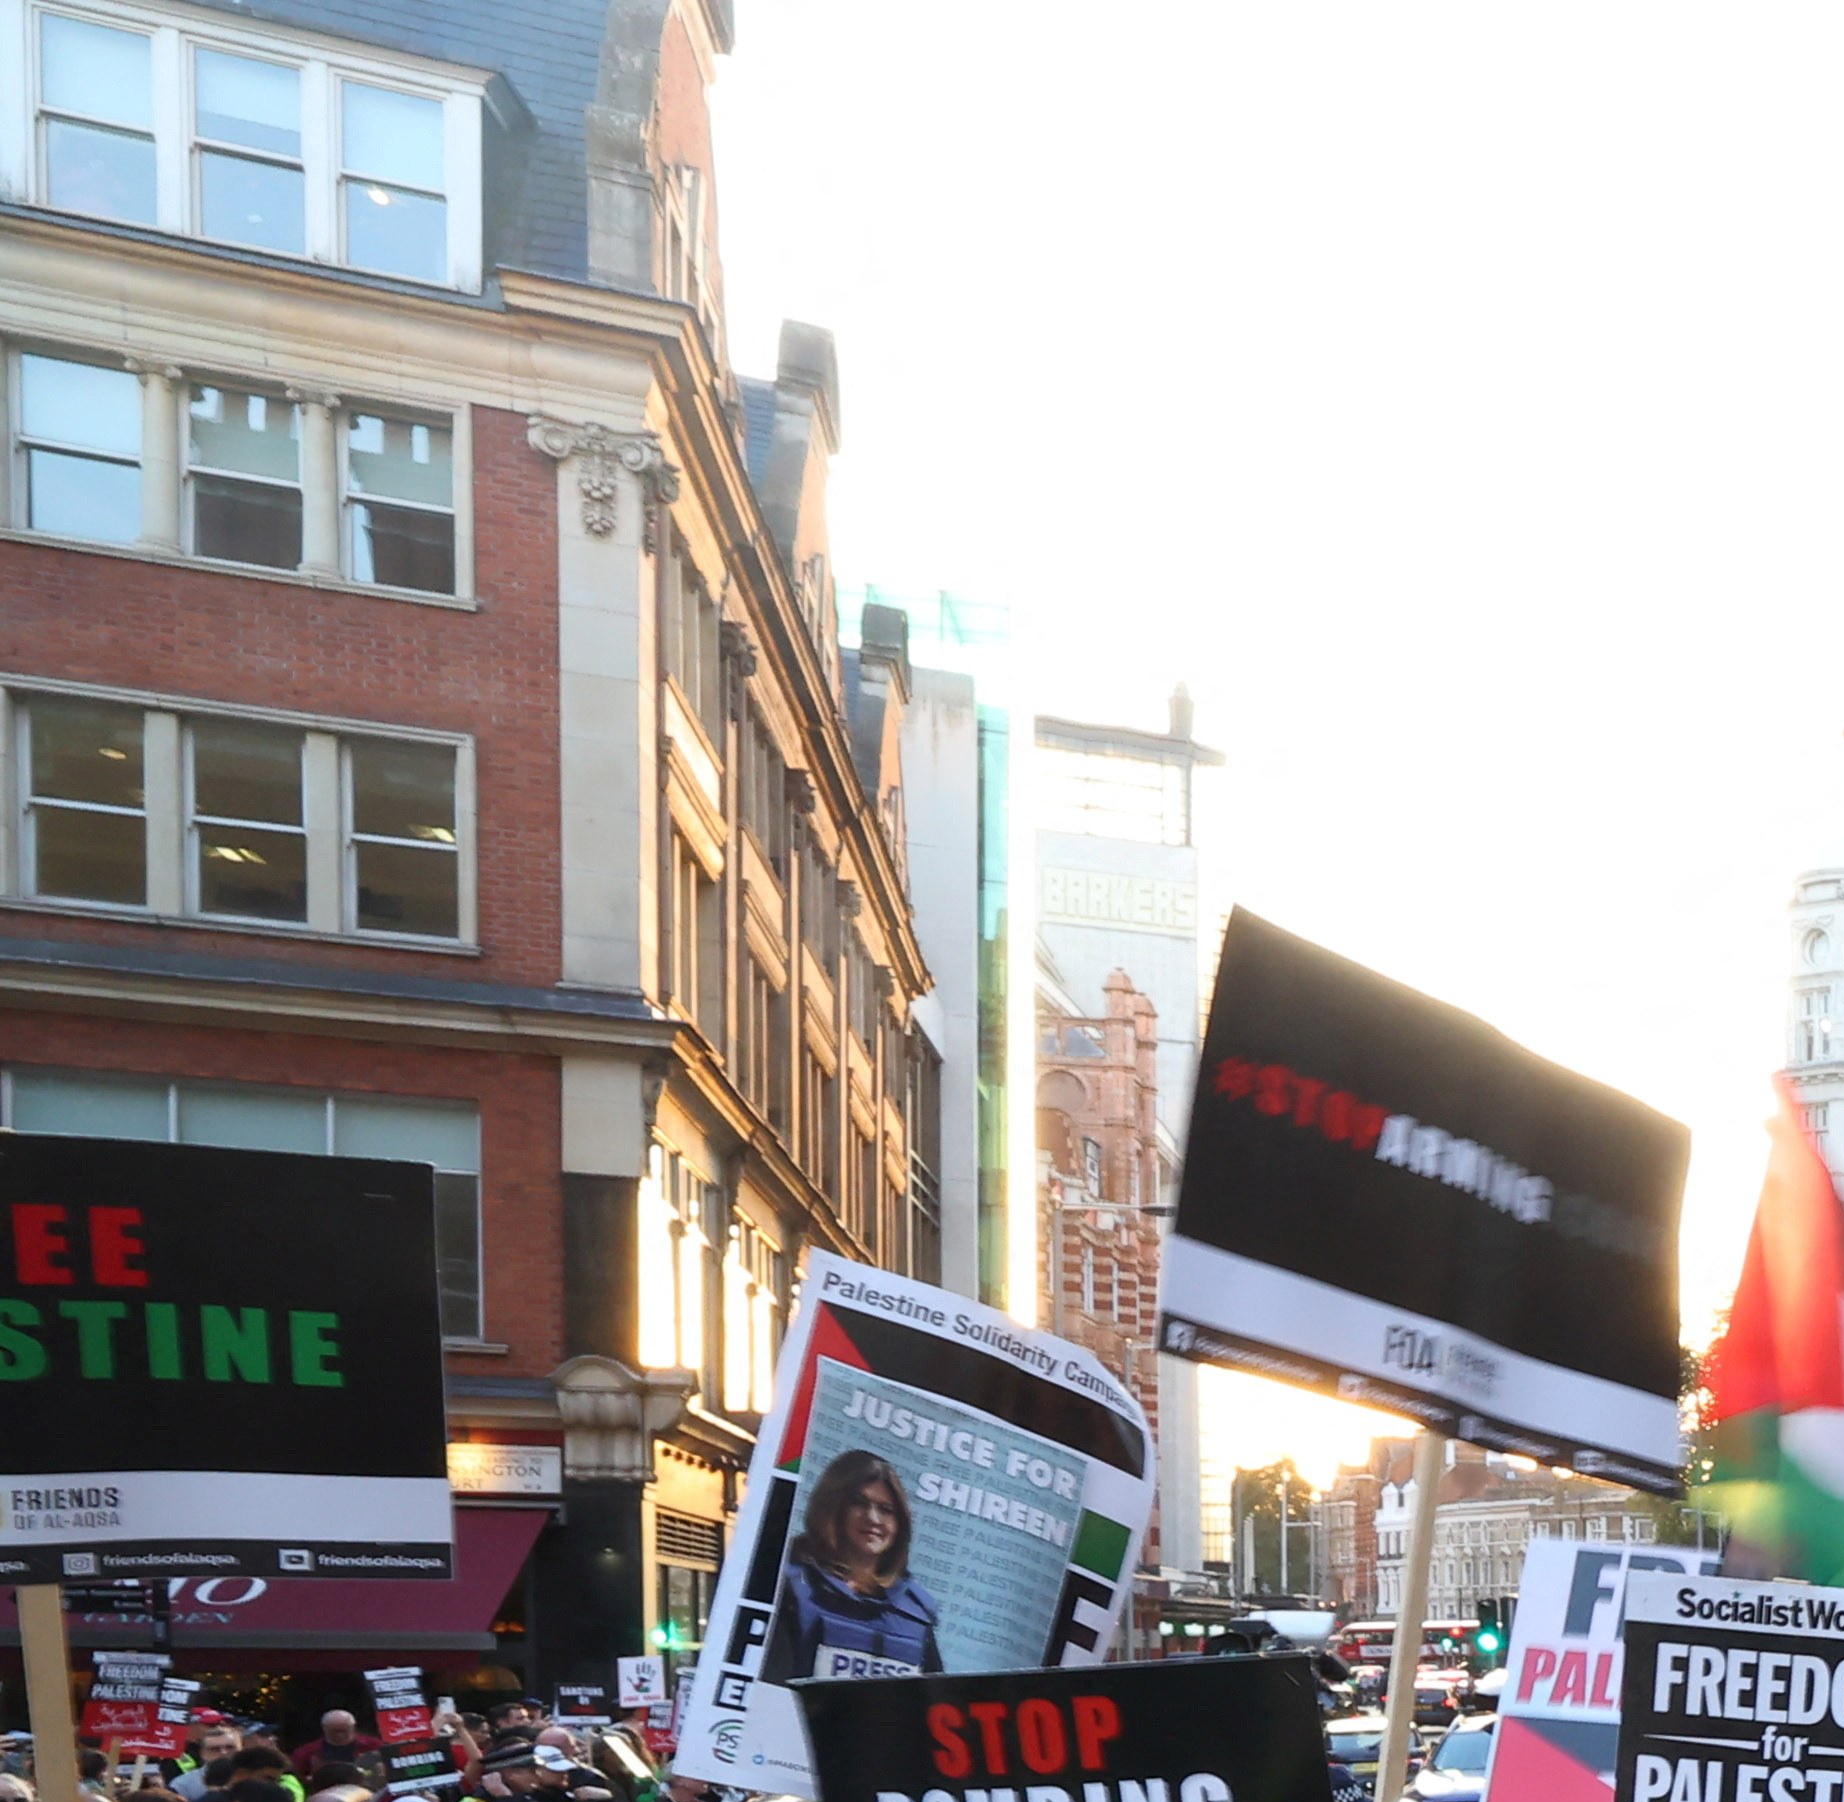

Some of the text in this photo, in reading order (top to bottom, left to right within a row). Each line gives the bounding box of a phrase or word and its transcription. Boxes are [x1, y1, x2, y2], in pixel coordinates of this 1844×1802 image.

[1044, 870, 1195, 928] BARKERS
[12, 1203, 149, 1288] EE
[822, 1269, 1140, 1422] Palestine Solidarity Campa
[842, 1389, 1078, 1501] JUSTICE FOR
[12, 1486, 120, 1511] FRIENDS
[13, 1510, 122, 1530] OF AL-AQSA
[916, 1471, 1070, 1548] SHIREEN
[102, 1552, 236, 1569] friendsofalaqsa
[317, 1553, 445, 1570] friendsofalaqsa
[1676, 1587, 1804, 1630] Socialist
[832, 1654, 911, 1678] PRESS
[926, 1694, 1123, 1780] STOP
[1761, 1724, 1810, 1763] for
